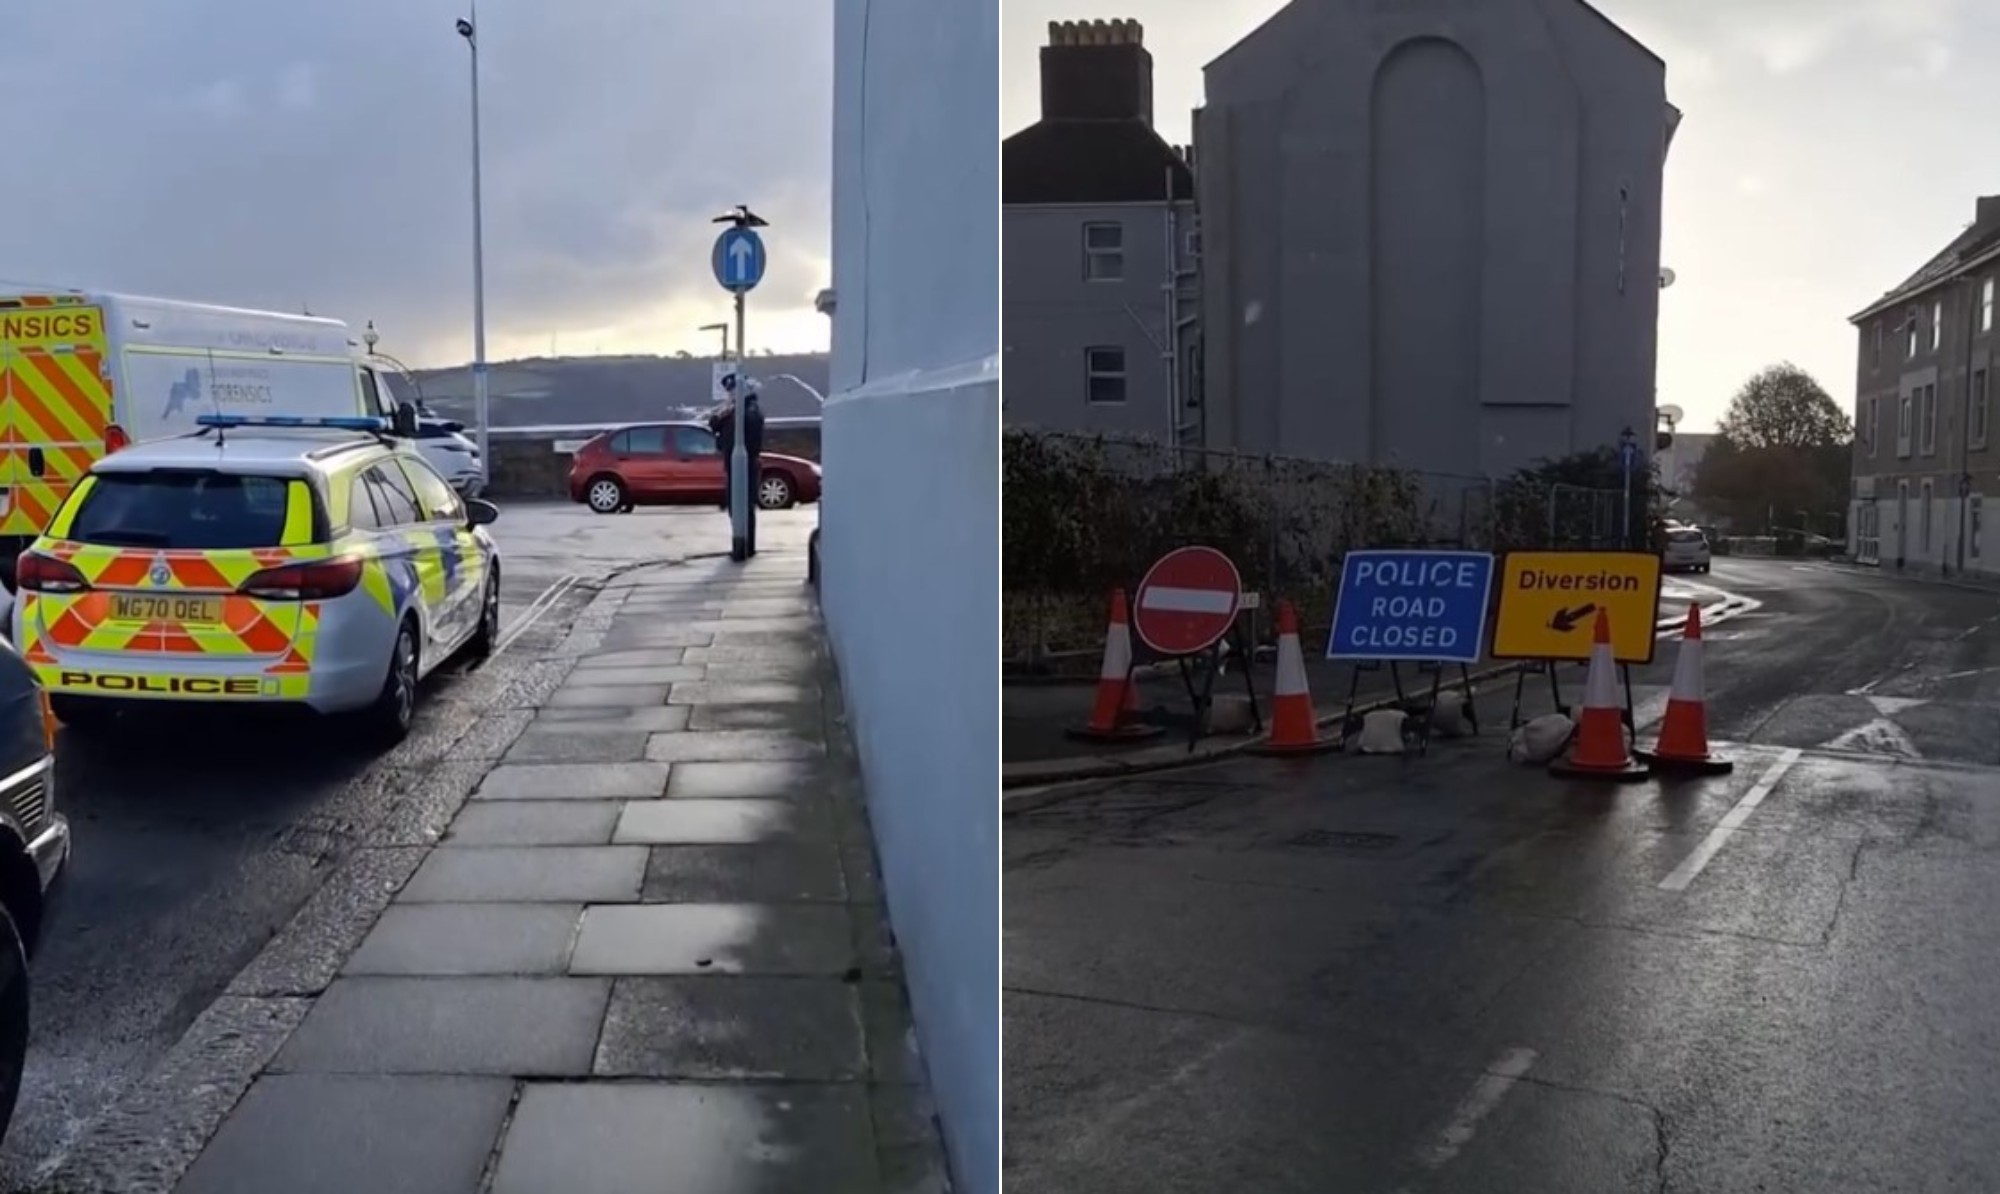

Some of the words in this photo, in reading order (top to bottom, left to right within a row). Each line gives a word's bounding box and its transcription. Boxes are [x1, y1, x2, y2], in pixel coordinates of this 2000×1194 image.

[0, 314, 91, 340] NSICS
[1355, 561, 1476, 587] POLICE
[1519, 570, 1639, 591] Diversion
[118, 597, 170, 618] WG70
[1371, 597, 1446, 618] ROAD
[1351, 626, 1457, 648] CLOSED
[61, 672, 259, 694] POLICE
